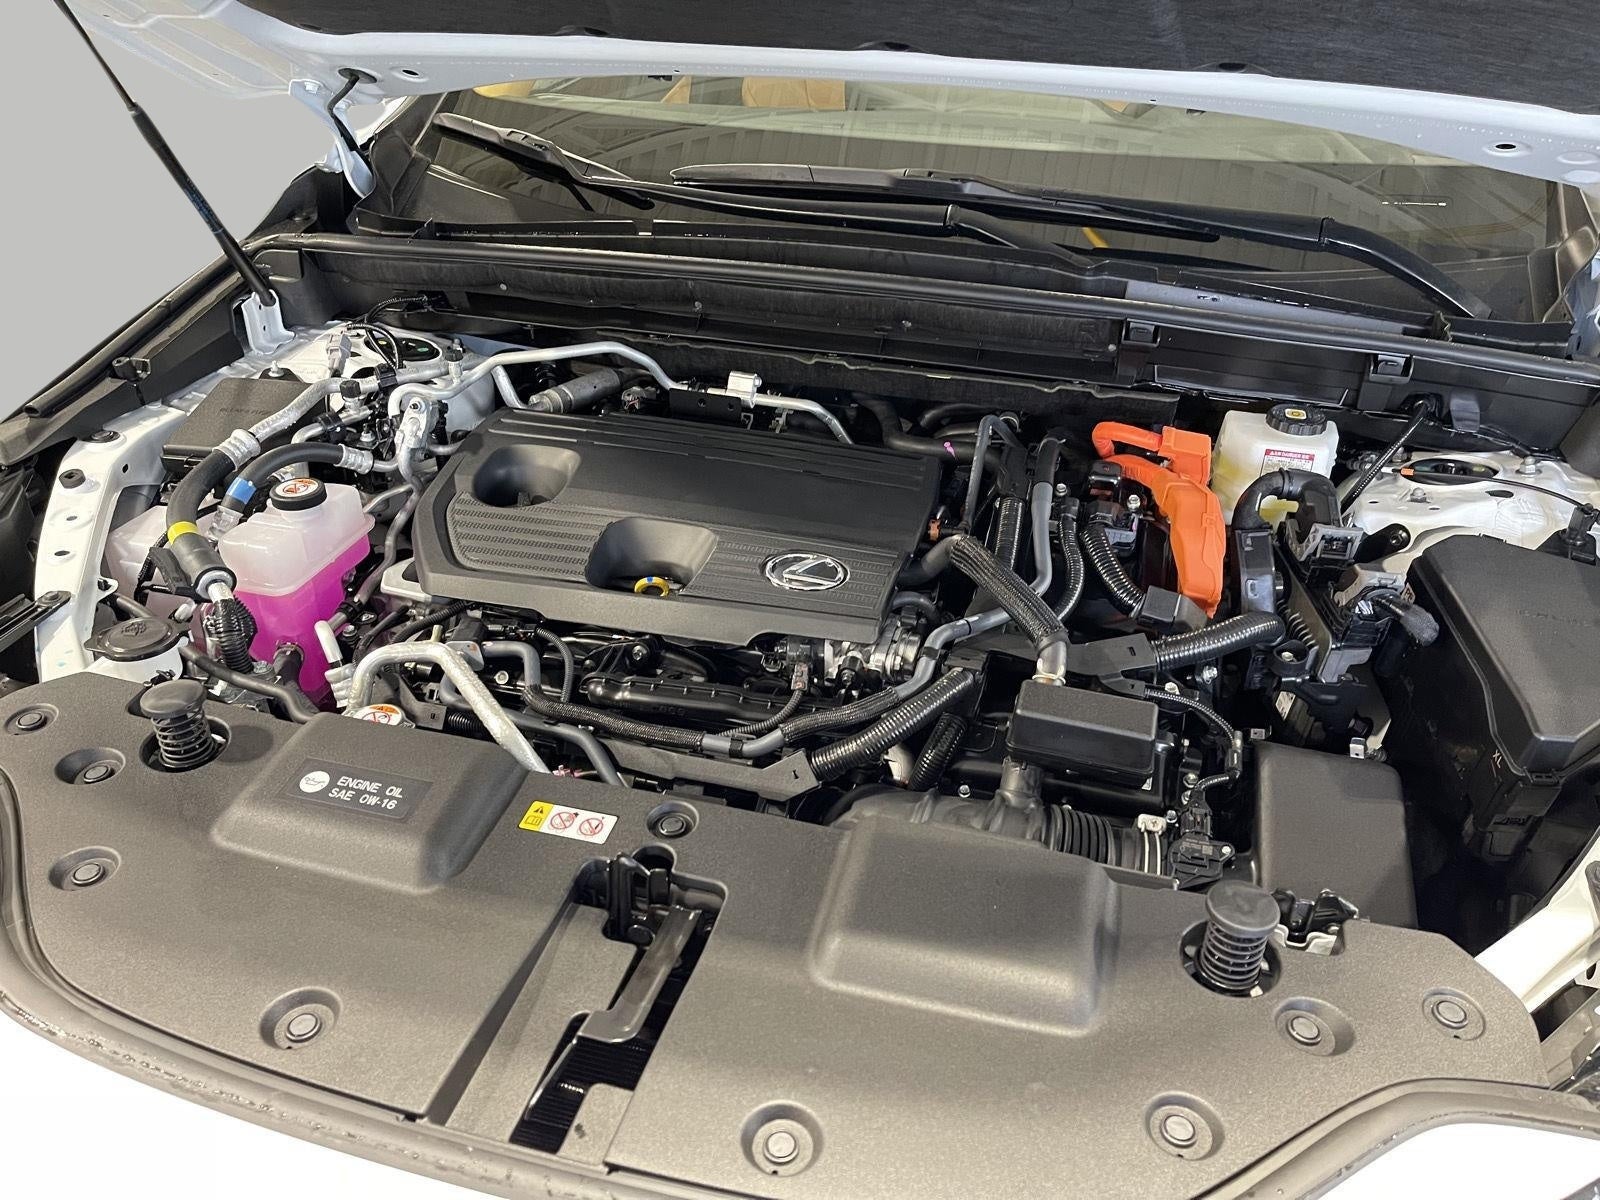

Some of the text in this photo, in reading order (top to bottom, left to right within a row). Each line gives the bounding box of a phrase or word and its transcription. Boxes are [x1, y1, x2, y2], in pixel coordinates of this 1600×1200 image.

[337, 776, 403, 798] ENGINE OIL
[328, 788, 397, 809] SAE 0W-16
